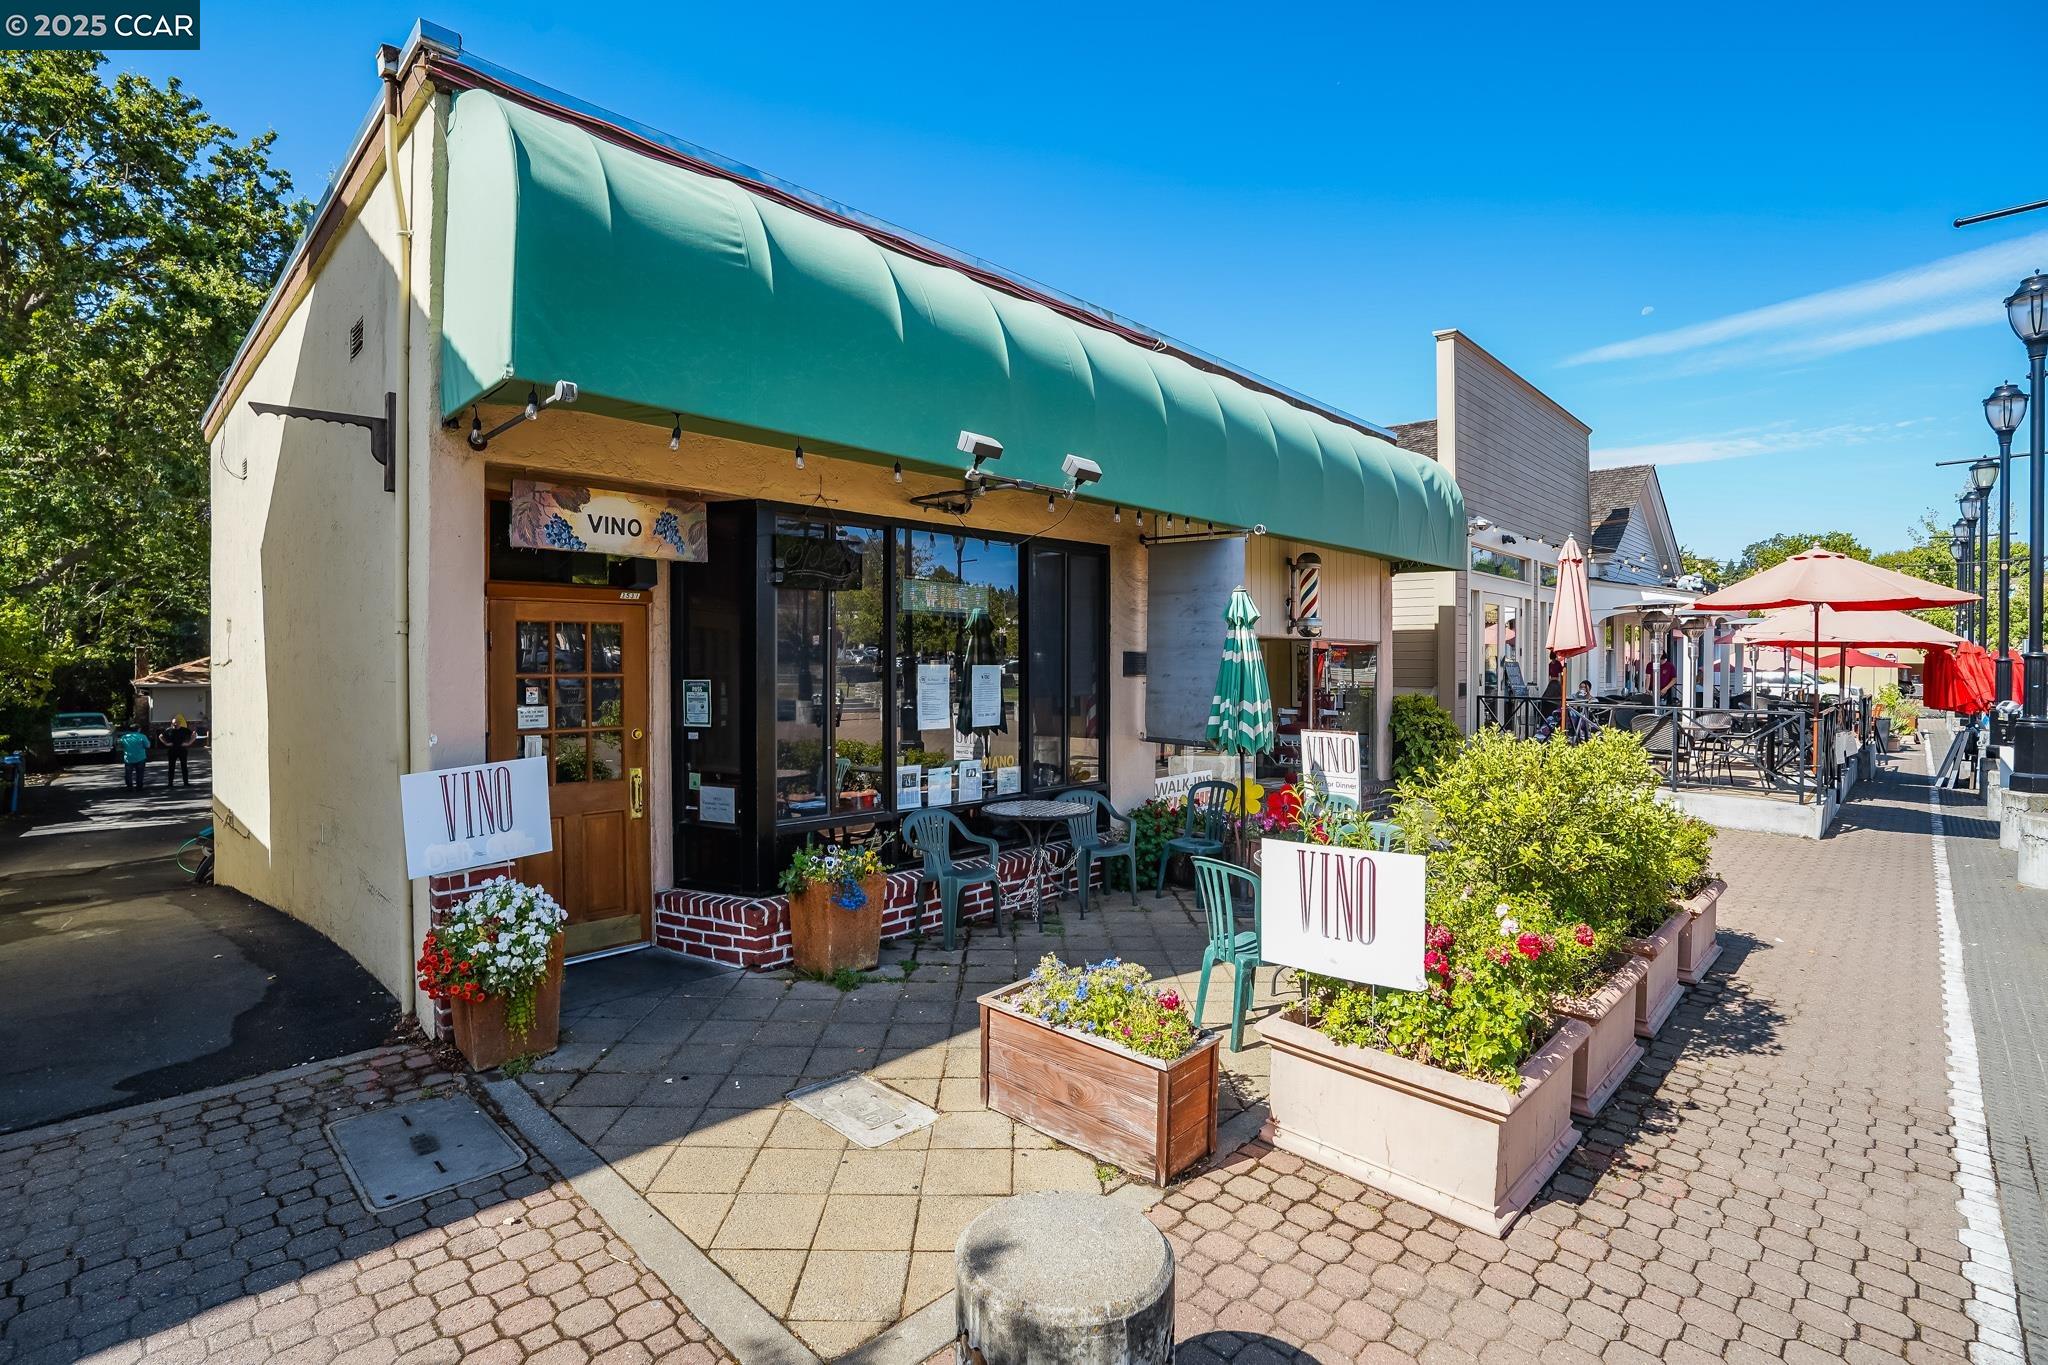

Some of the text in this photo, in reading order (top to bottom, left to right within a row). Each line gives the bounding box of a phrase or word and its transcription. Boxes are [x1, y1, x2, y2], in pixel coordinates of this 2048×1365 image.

[587, 513, 643, 537] VINO
[980, 754, 1016, 771] PIANO
[1306, 735, 1356, 774] VINO
[1336, 781, 1357, 790] Dinner
[438, 766, 514, 842] VINO
[1296, 849, 1377, 946] VINO
